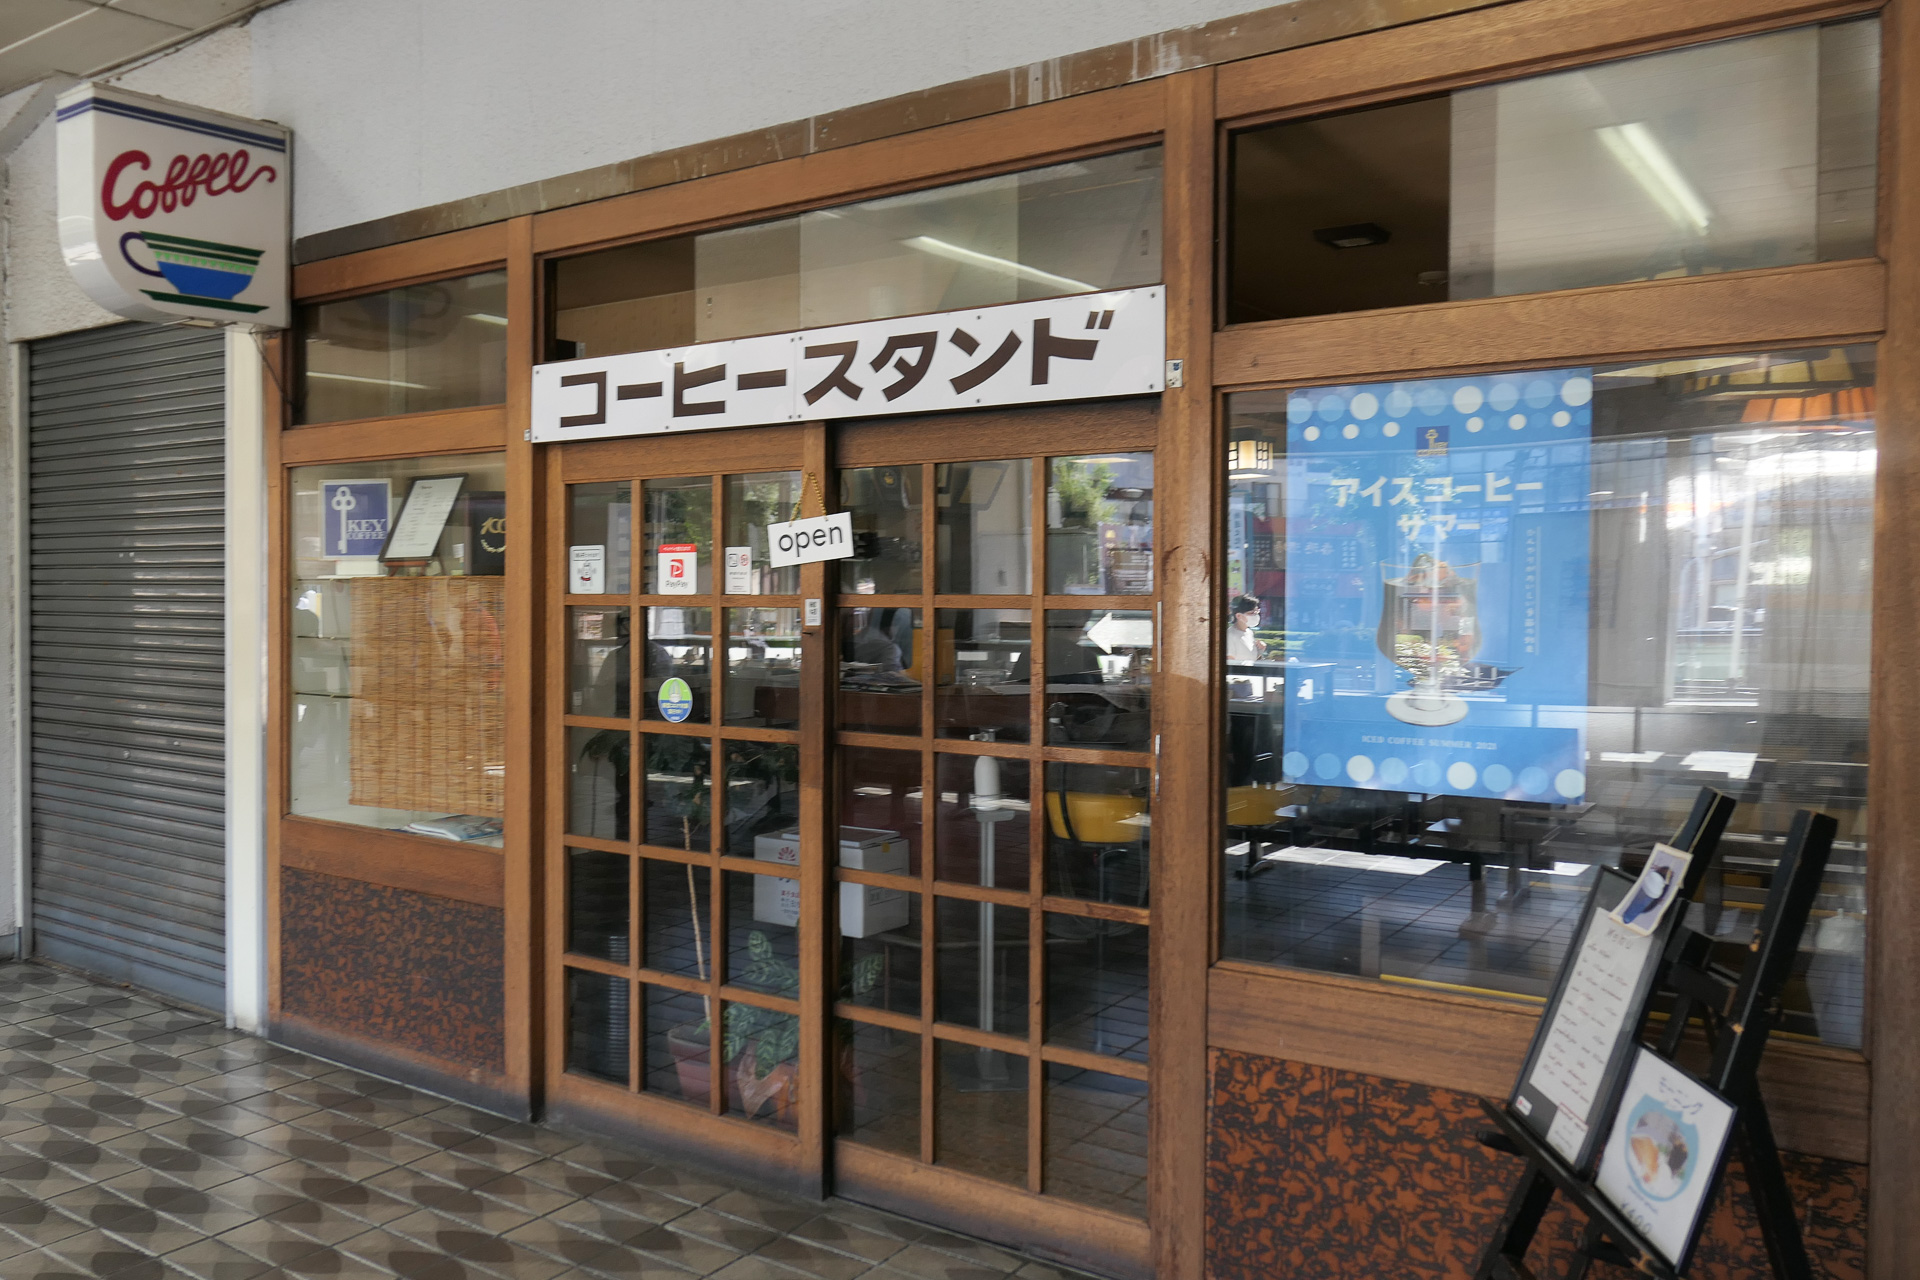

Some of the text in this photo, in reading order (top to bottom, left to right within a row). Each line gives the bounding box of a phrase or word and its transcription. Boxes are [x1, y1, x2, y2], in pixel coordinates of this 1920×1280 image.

[102, 149, 276, 221] Coffee
[560, 309, 1115, 428] コーヒースタンド
[1330, 472, 1543, 508] アイスコーヒー
[347, 519, 386, 532] KEY
[347, 531, 386, 540] COFFEE
[778, 524, 843, 557] open
[1398, 514, 1480, 542] サマー
[1387, 736, 1425, 746] COFFEE
[1428, 739, 1472, 749] SUMMER
